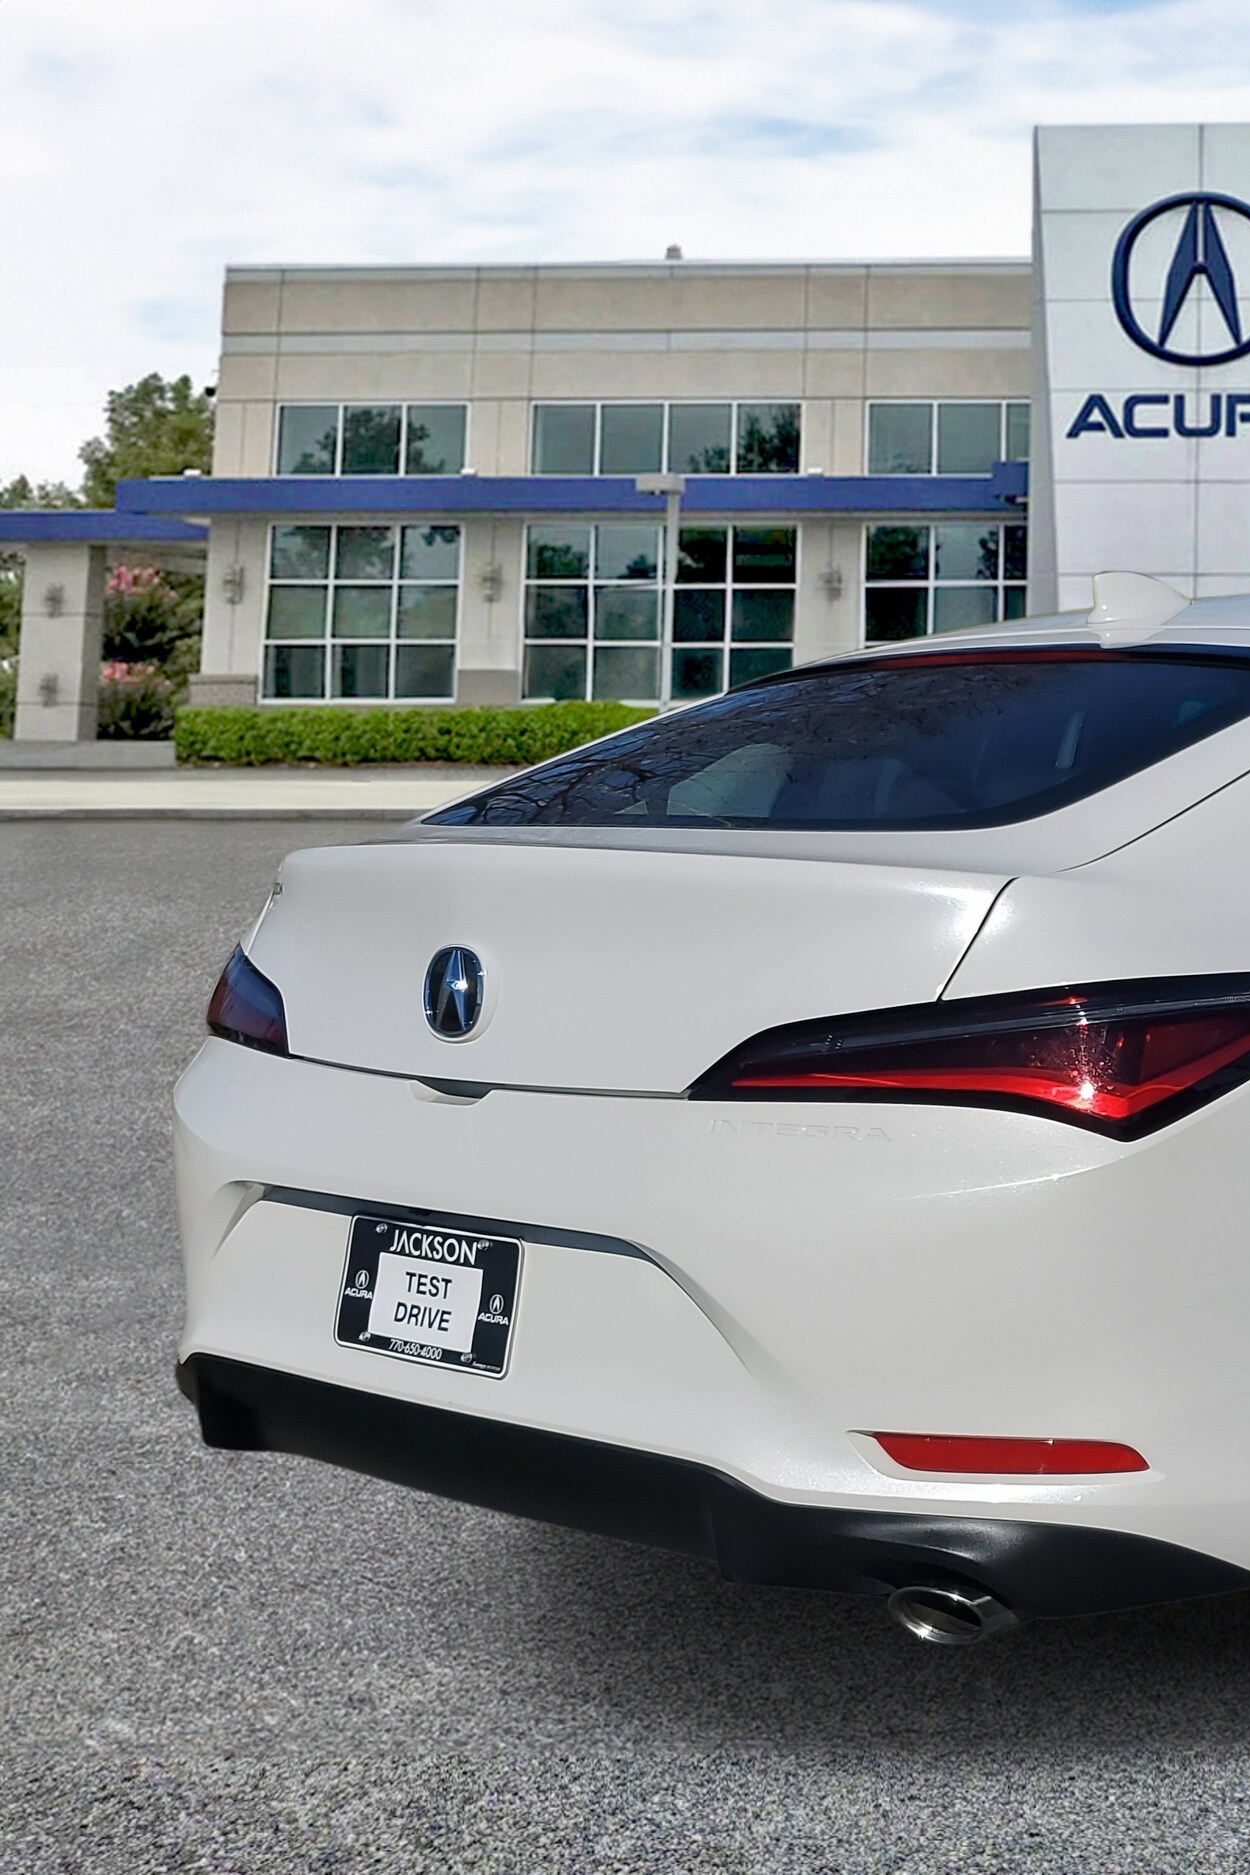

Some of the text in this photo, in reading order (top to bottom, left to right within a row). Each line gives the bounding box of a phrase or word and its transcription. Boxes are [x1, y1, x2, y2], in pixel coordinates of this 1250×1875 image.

[707, 1119, 891, 1142] INTEGRA
[389, 1229, 478, 1265] JACKSON
[344, 1287, 373, 1300] ACURA
[405, 1271, 452, 1299] TEST
[394, 1301, 452, 1332] DRIVE
[477, 1312, 510, 1326] ACURA
[388, 1338, 443, 1360] 770-650-4000
